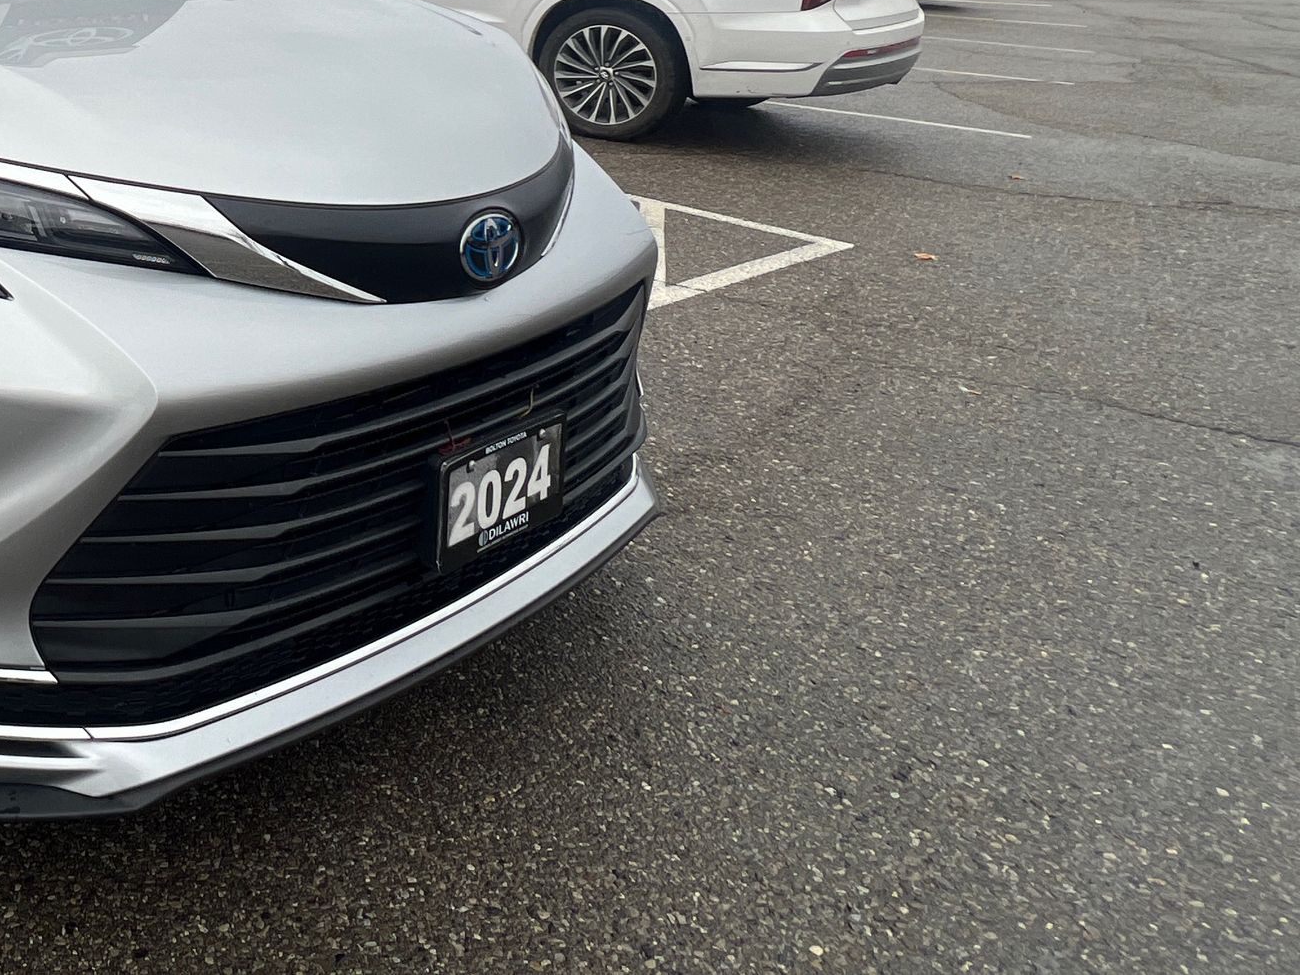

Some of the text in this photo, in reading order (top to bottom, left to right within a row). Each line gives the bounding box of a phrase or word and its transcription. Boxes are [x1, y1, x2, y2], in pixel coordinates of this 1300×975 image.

[485, 431, 528, 455] BOLTON TOYOTA
[448, 443, 551, 547] 2024
[488, 511, 529, 541] DILAWRI
